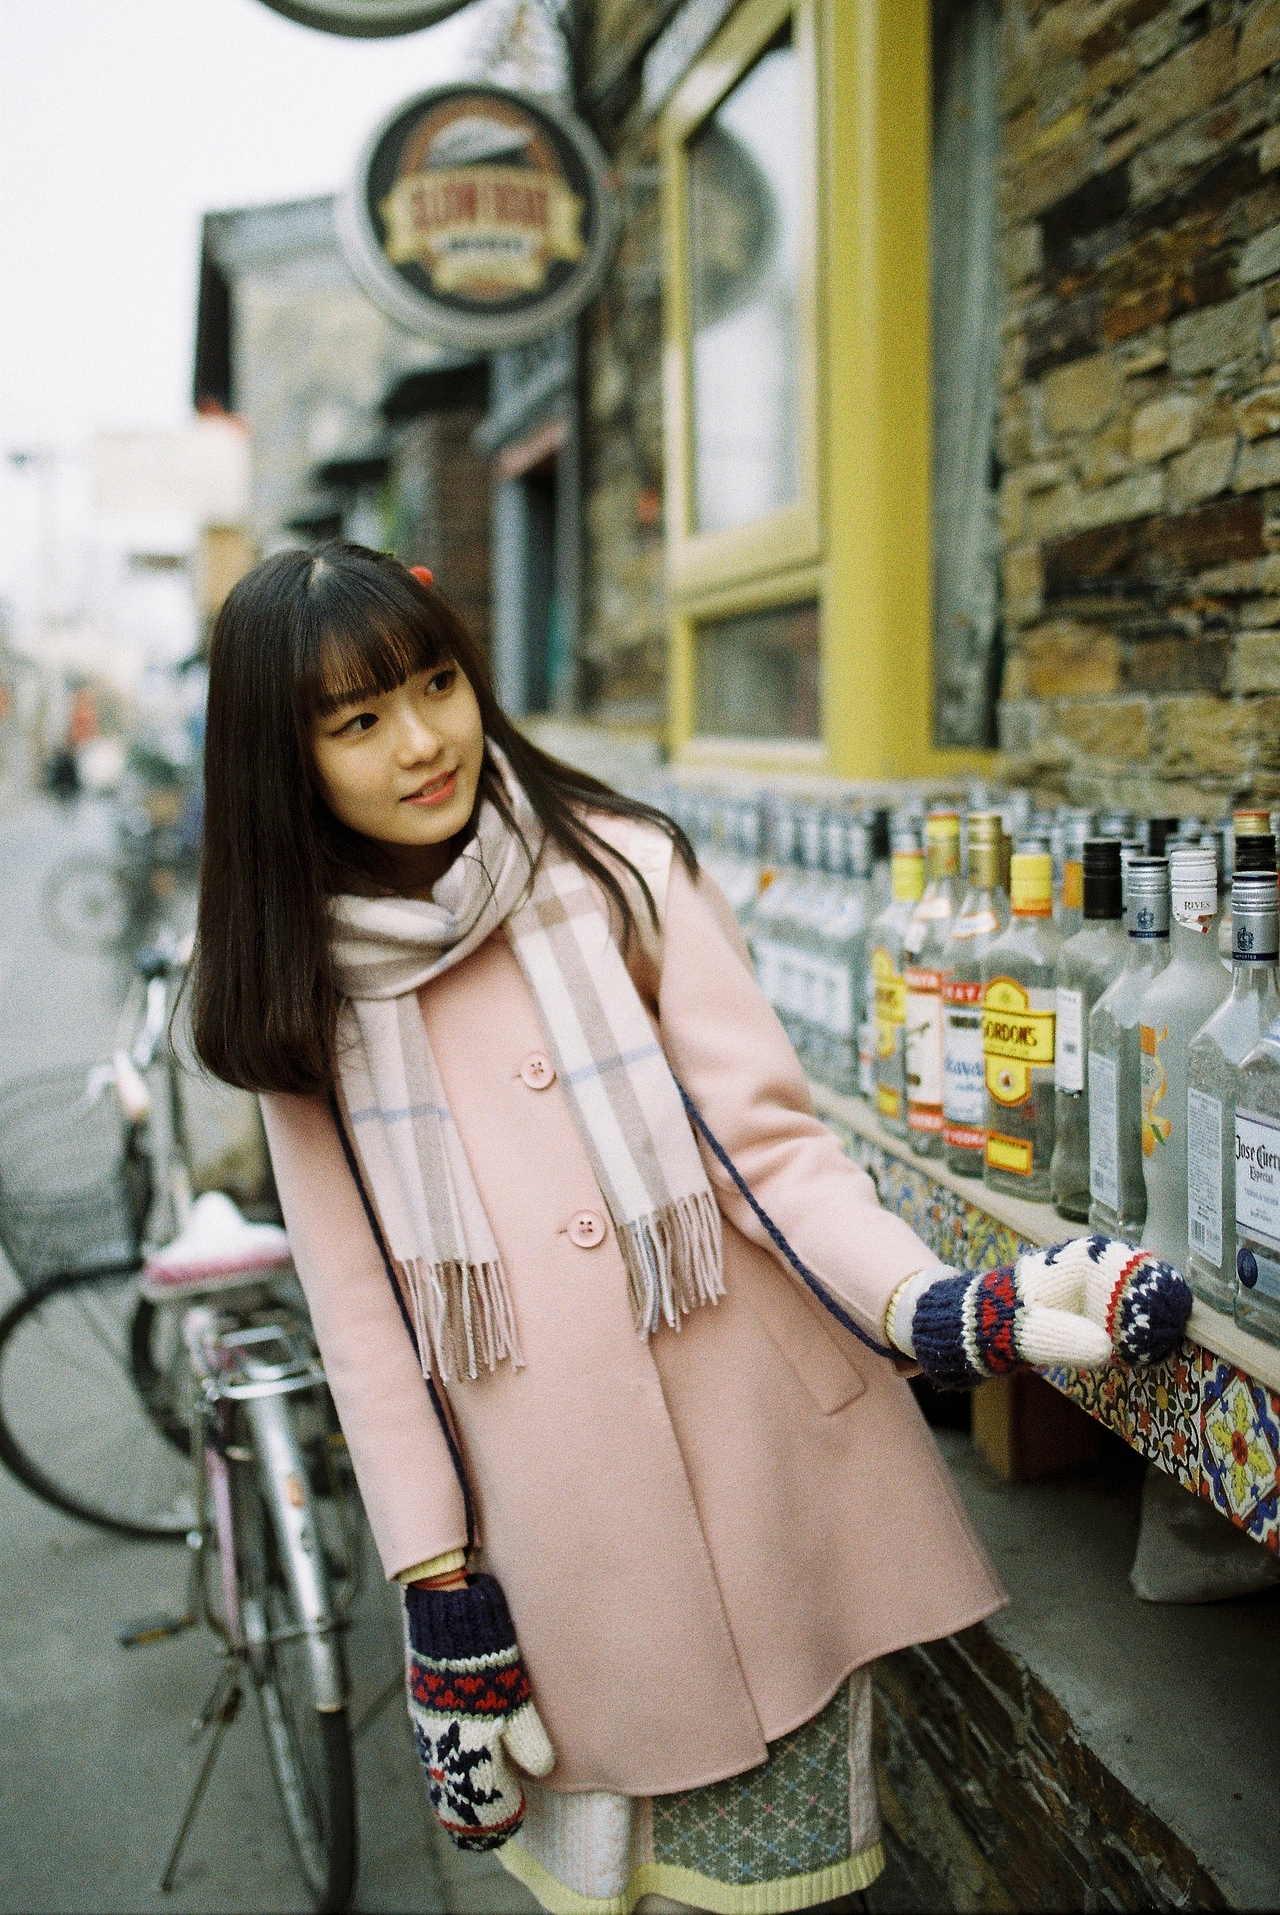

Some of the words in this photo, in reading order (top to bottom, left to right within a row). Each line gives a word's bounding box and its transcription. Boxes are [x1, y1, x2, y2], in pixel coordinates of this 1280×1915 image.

[1184, 901, 1211, 911] RIVES
[1236, 1134, 1255, 1161] Jose
[1249, 1165, 1274, 1185] Especial
